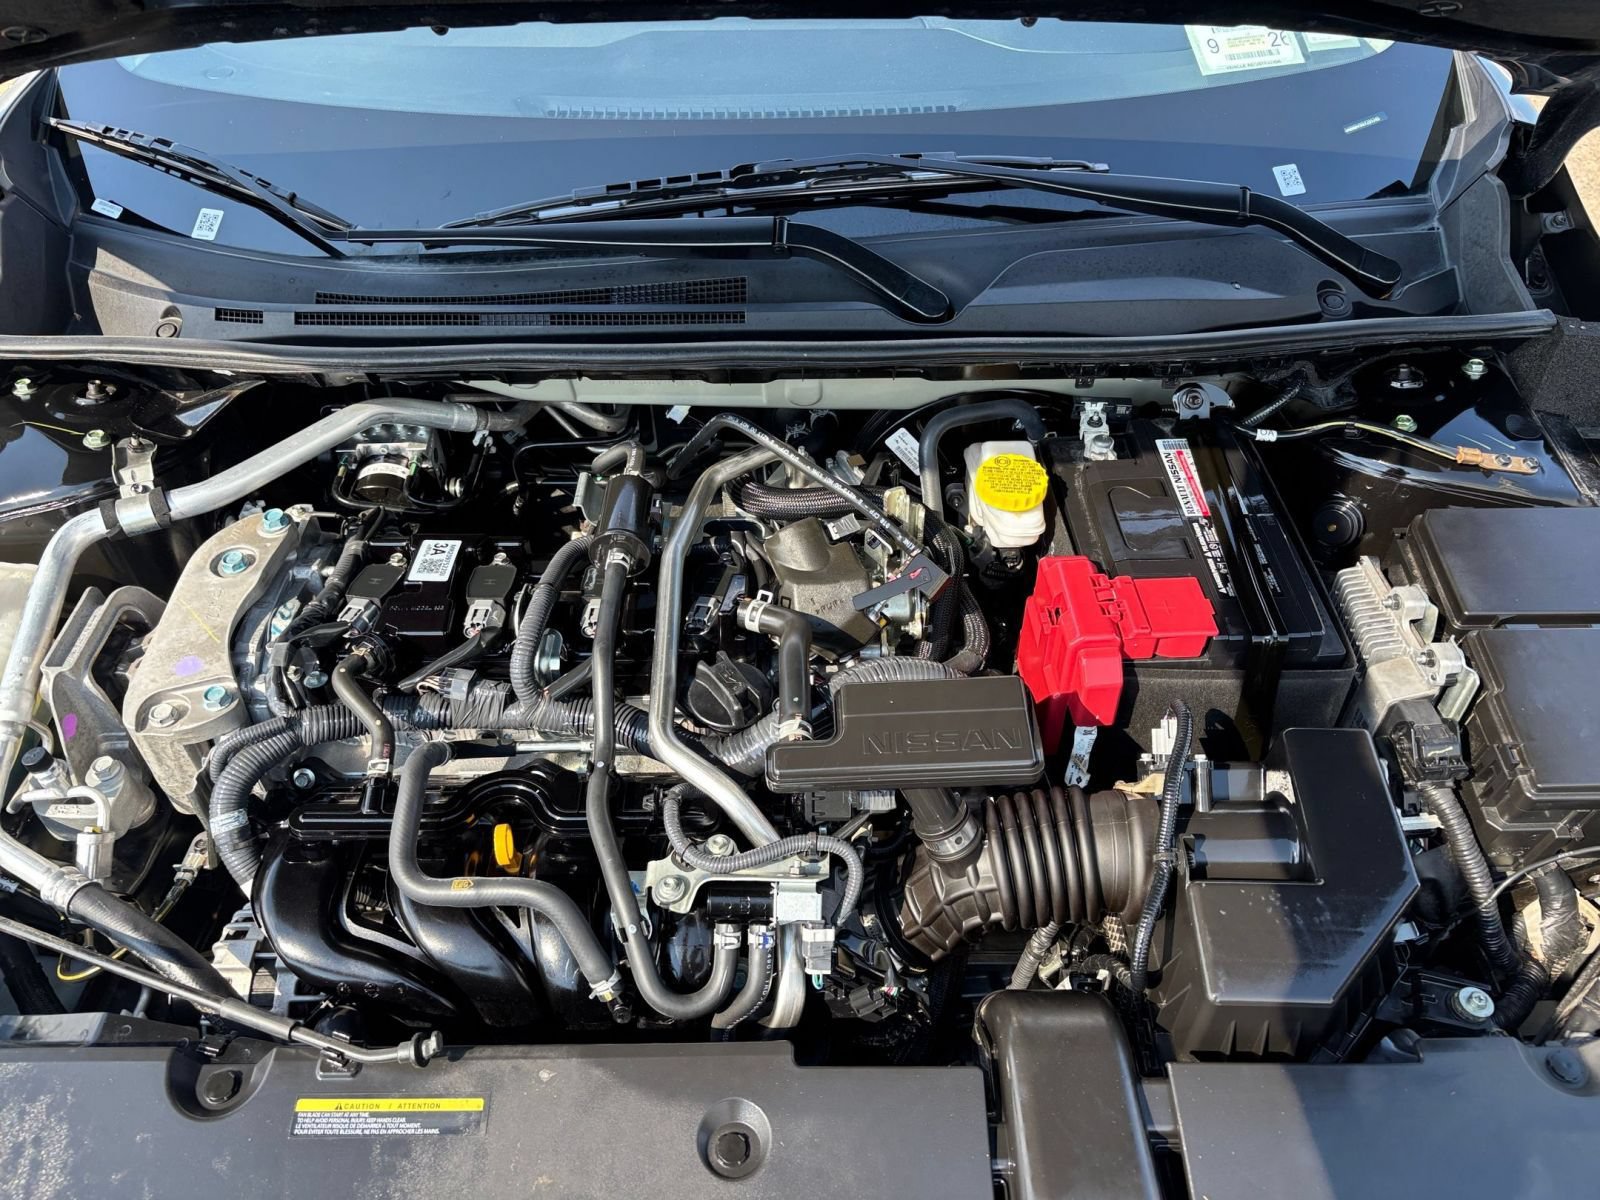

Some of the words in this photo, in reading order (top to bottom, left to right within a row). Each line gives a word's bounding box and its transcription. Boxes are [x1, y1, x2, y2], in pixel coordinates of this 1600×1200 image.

[1207, 38, 1220, 54] 9
[1162, 452, 1182, 483] NISSAN
[1175, 484, 1195, 514] RENAULT
[431, 543, 449, 556] 3A
[862, 727, 1023, 755] NISSAN
